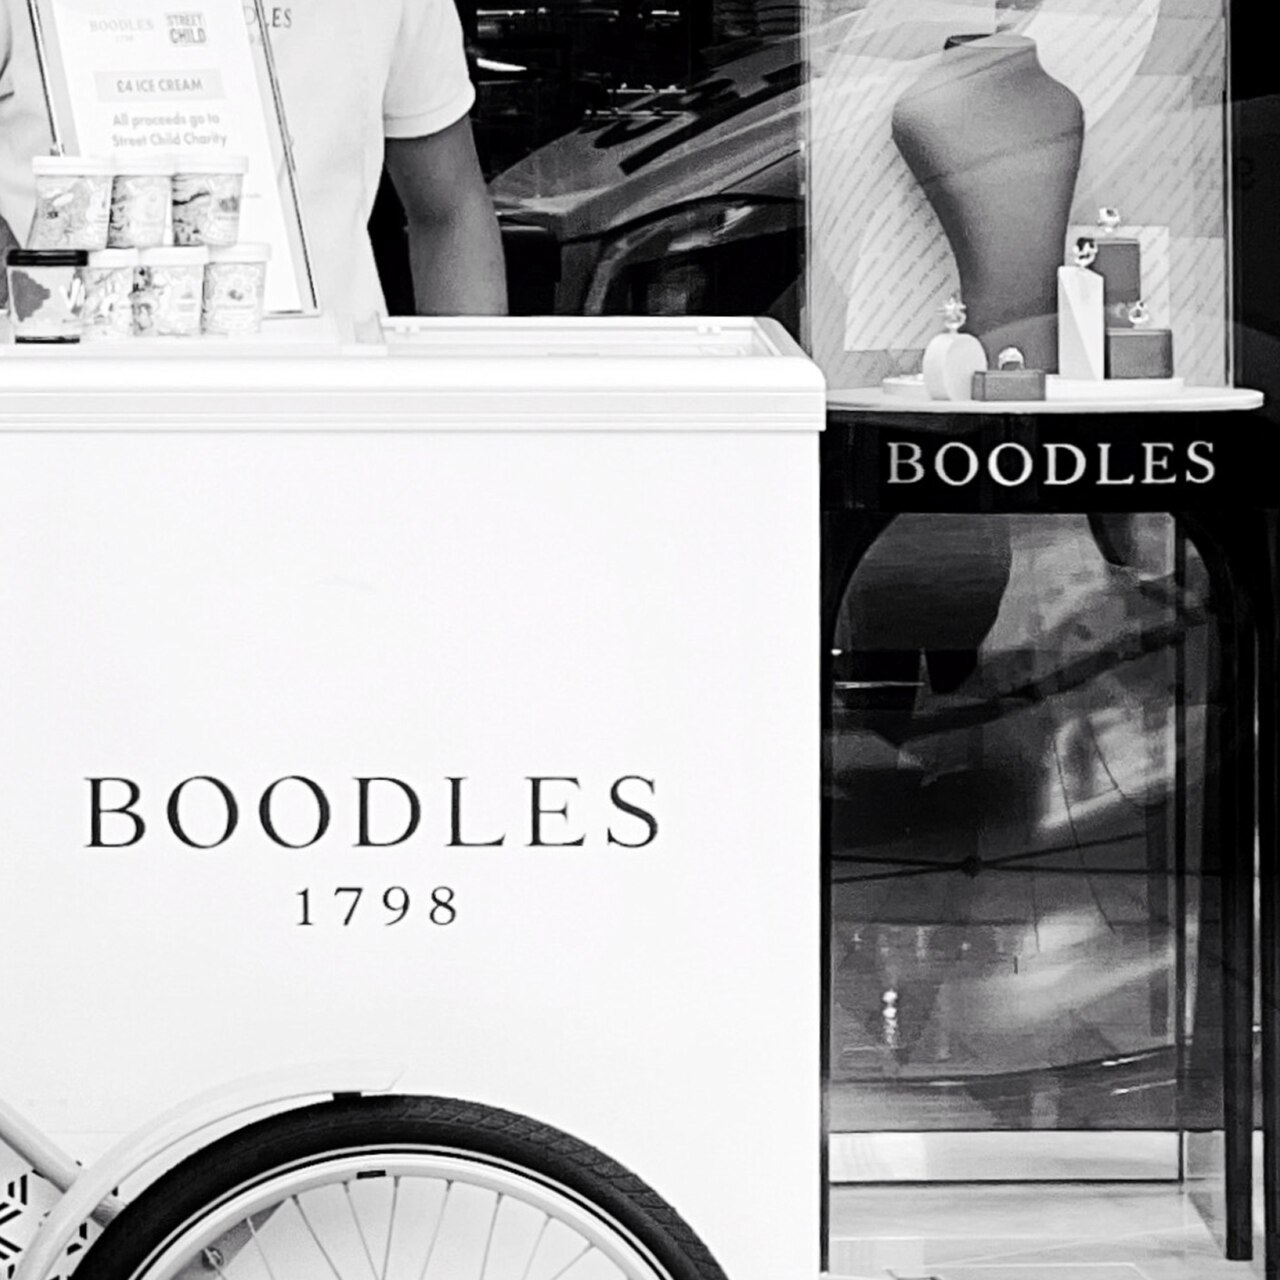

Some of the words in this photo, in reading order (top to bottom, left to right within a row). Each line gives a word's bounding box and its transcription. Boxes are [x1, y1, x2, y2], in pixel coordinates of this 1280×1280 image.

[167, 14, 203, 26] STREET
[169, 27, 207, 44] CHILD
[116, 79, 133, 94] £4
[136, 79, 156, 93] ICE
[158, 78, 204, 92] CREAM
[112, 112, 130, 127] All
[131, 111, 187, 129] proceeds
[189, 115, 205, 129] go
[207, 112, 221, 125] to
[111, 133, 148, 148] Street
[149, 132, 181, 147] Child
[183, 131, 228, 148] Charity
[887, 440, 1217, 487] BOODLES
[87, 774, 659, 850] BOODLES
[297, 885, 458, 927] 1798
